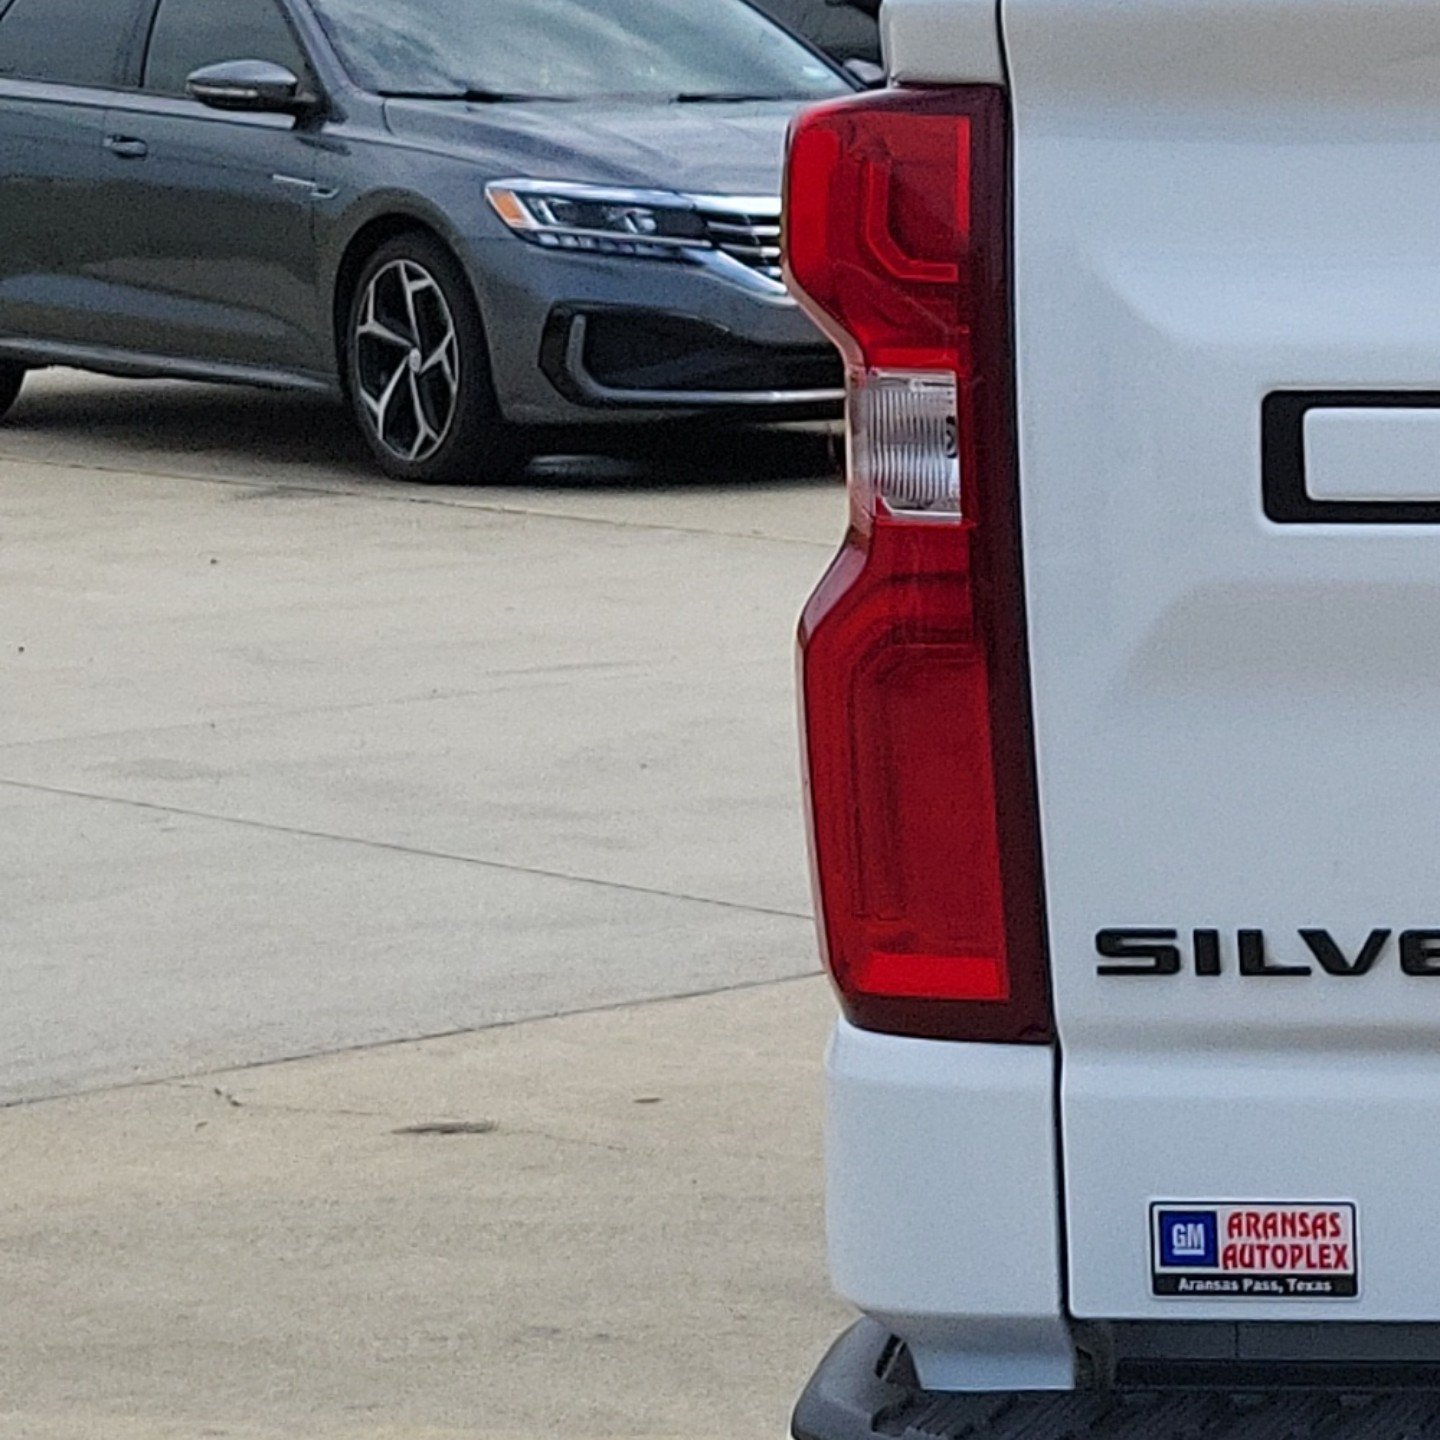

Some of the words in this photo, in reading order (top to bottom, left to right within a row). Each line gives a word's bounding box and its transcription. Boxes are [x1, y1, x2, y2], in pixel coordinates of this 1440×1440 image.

[1172, 1223, 1205, 1255] GM
[1226, 1212, 1342, 1240] ARANSAS
[1222, 1243, 1349, 1270] AUTOPLEX
[1178, 1277, 1239, 1292] Aransas
[1243, 1278, 1284, 1294] Pass,
[1287, 1278, 1333, 1292] Texas
